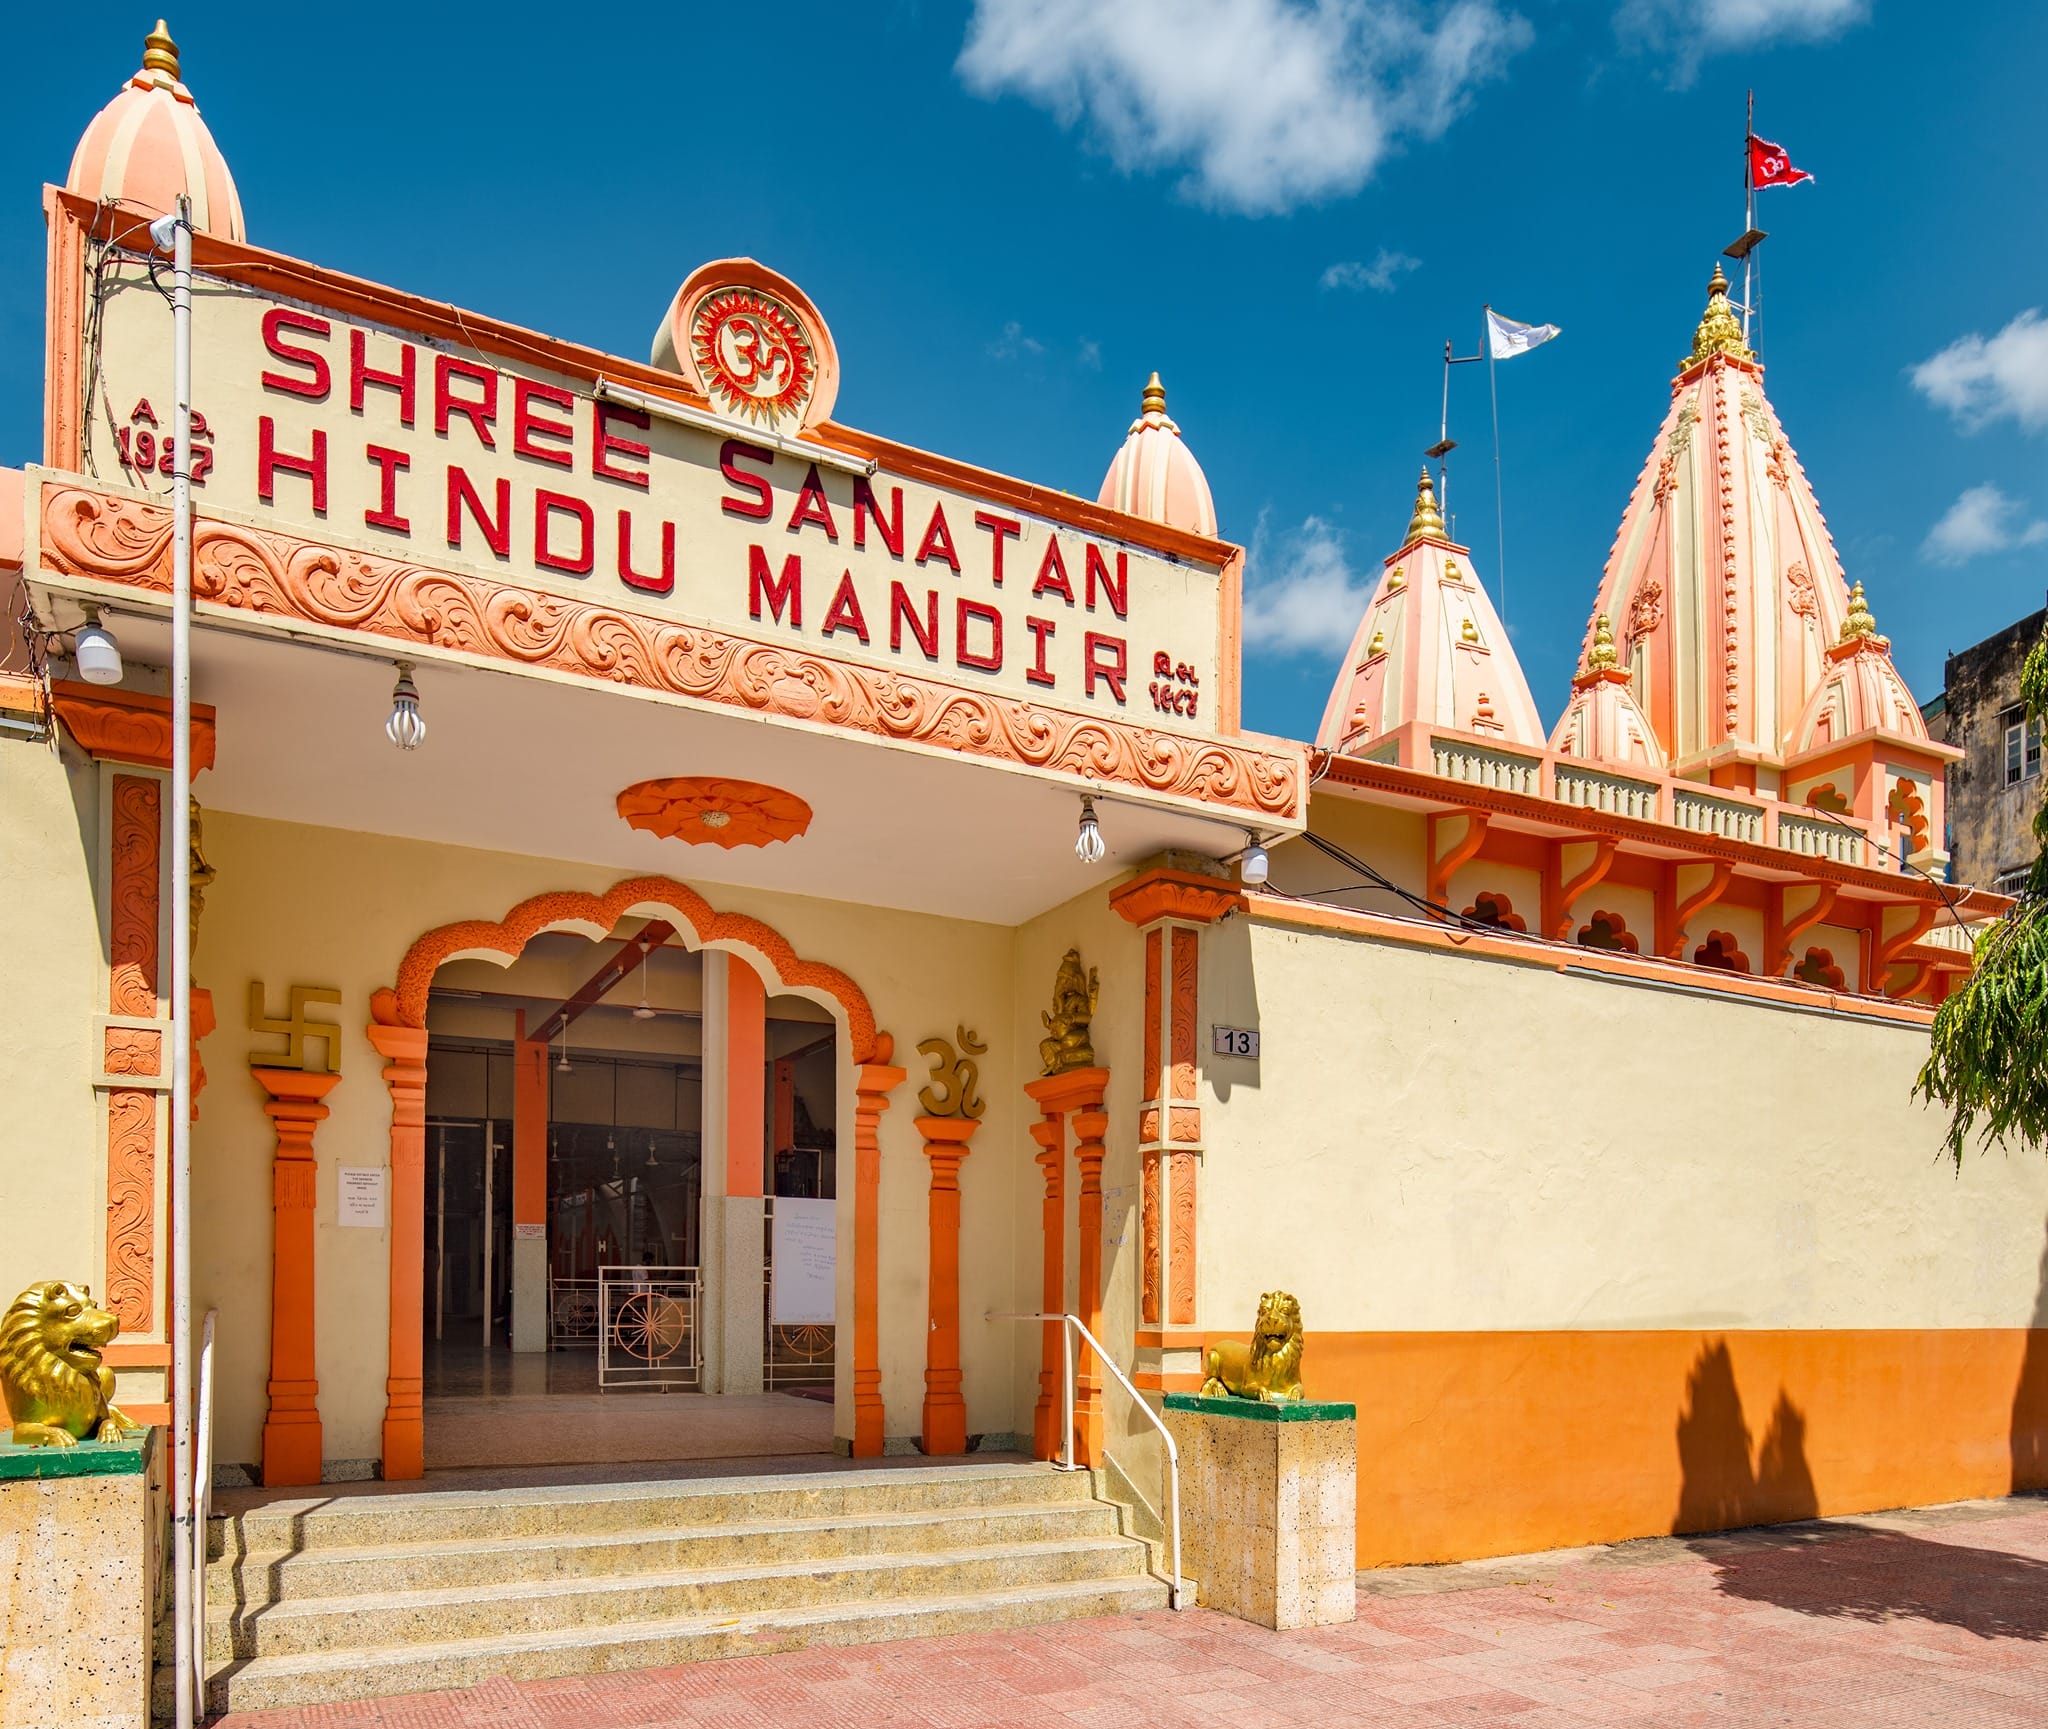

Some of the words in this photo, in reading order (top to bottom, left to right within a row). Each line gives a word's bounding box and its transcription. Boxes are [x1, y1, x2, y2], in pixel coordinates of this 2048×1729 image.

[118, 426, 214, 484] 1927
[261, 308, 651, 488] SHREE
[719, 438, 1128, 616] SANATAN
[258, 415, 676, 592] HINDU
[748, 543, 1127, 702] MANDIR
[1224, 1031, 1250, 1054] 13
